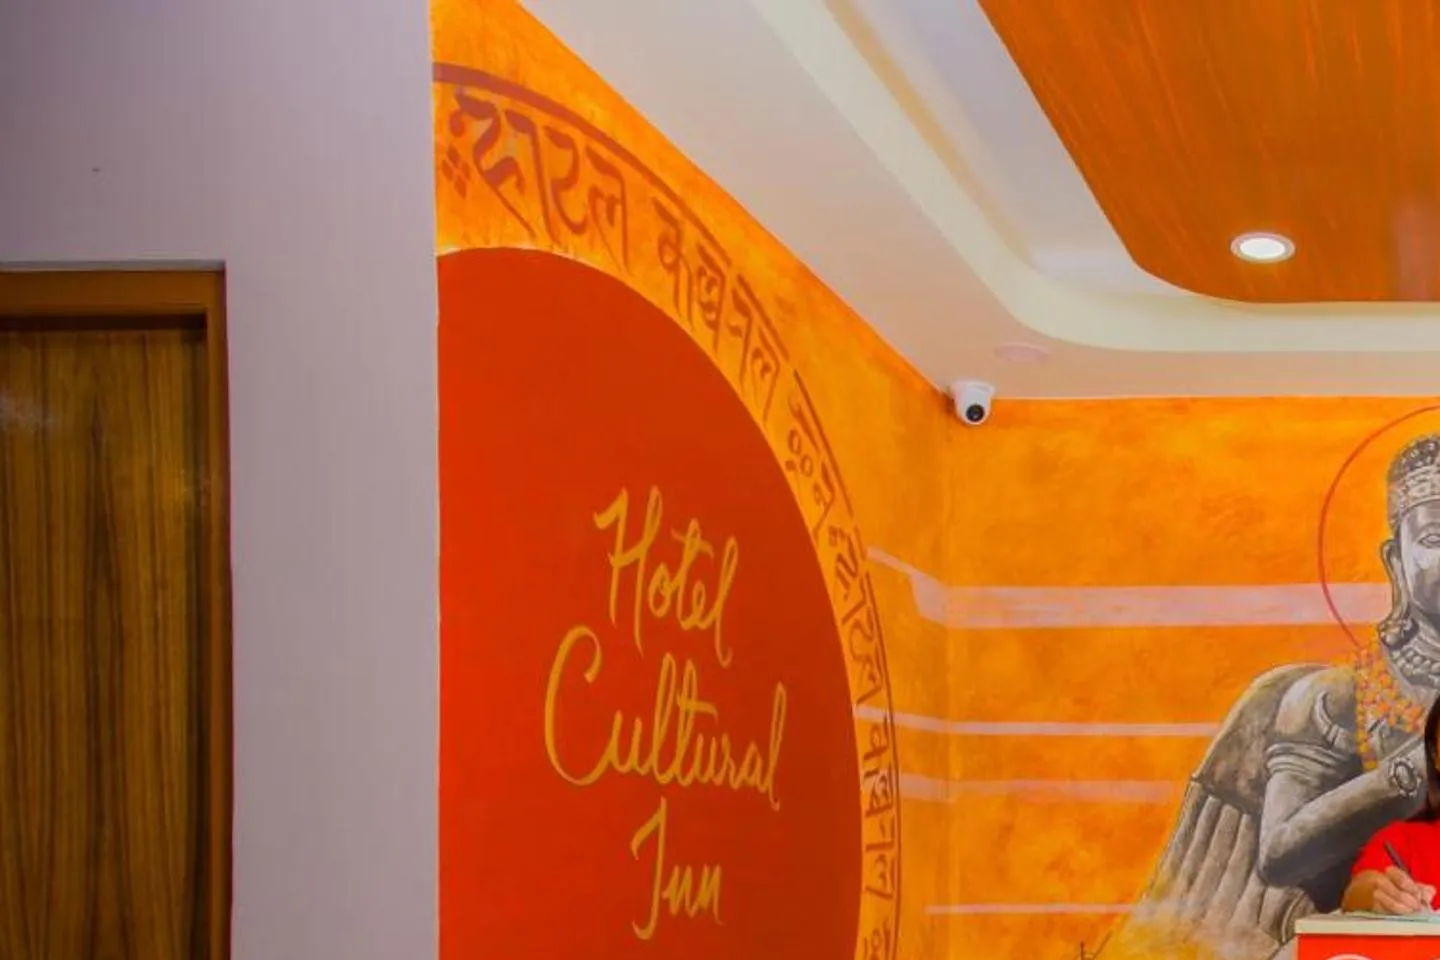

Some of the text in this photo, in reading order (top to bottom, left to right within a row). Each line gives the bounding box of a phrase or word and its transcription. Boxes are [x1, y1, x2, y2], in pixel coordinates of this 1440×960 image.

[593, 484, 739, 669] Hotel
[543, 625, 788, 812] Cultural
[630, 796, 724, 941] Inn
